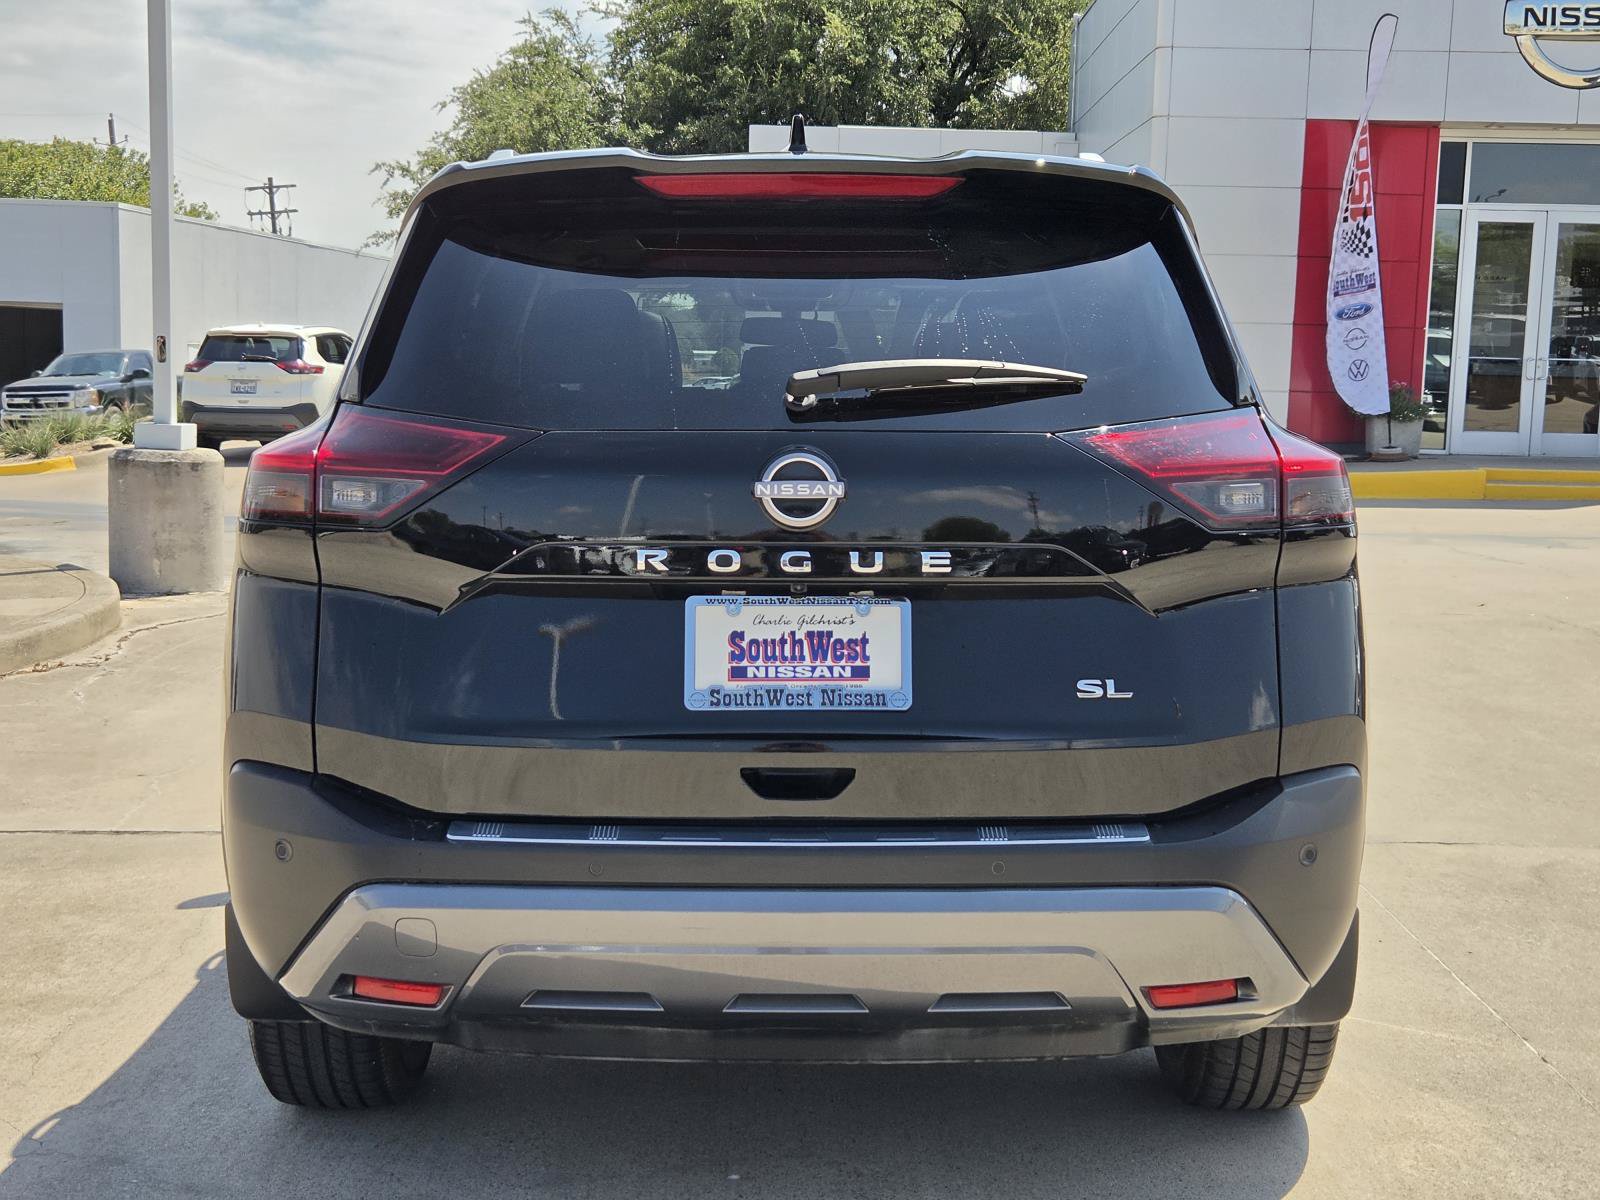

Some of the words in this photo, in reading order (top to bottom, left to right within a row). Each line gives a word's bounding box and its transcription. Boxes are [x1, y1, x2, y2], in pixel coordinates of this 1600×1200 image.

[756, 483, 843, 496] NISSAN
[636, 549, 953, 573] ROGUE
[753, 614, 792, 626] Charlie
[797, 613, 856, 631] Gilchrist's
[728, 630, 870, 664] SouthWest
[746, 666, 852, 678] NISSAN
[709, 688, 813, 708] SouthWest
[821, 688, 888, 708] Nissan
[1076, 679, 1134, 698] SL
